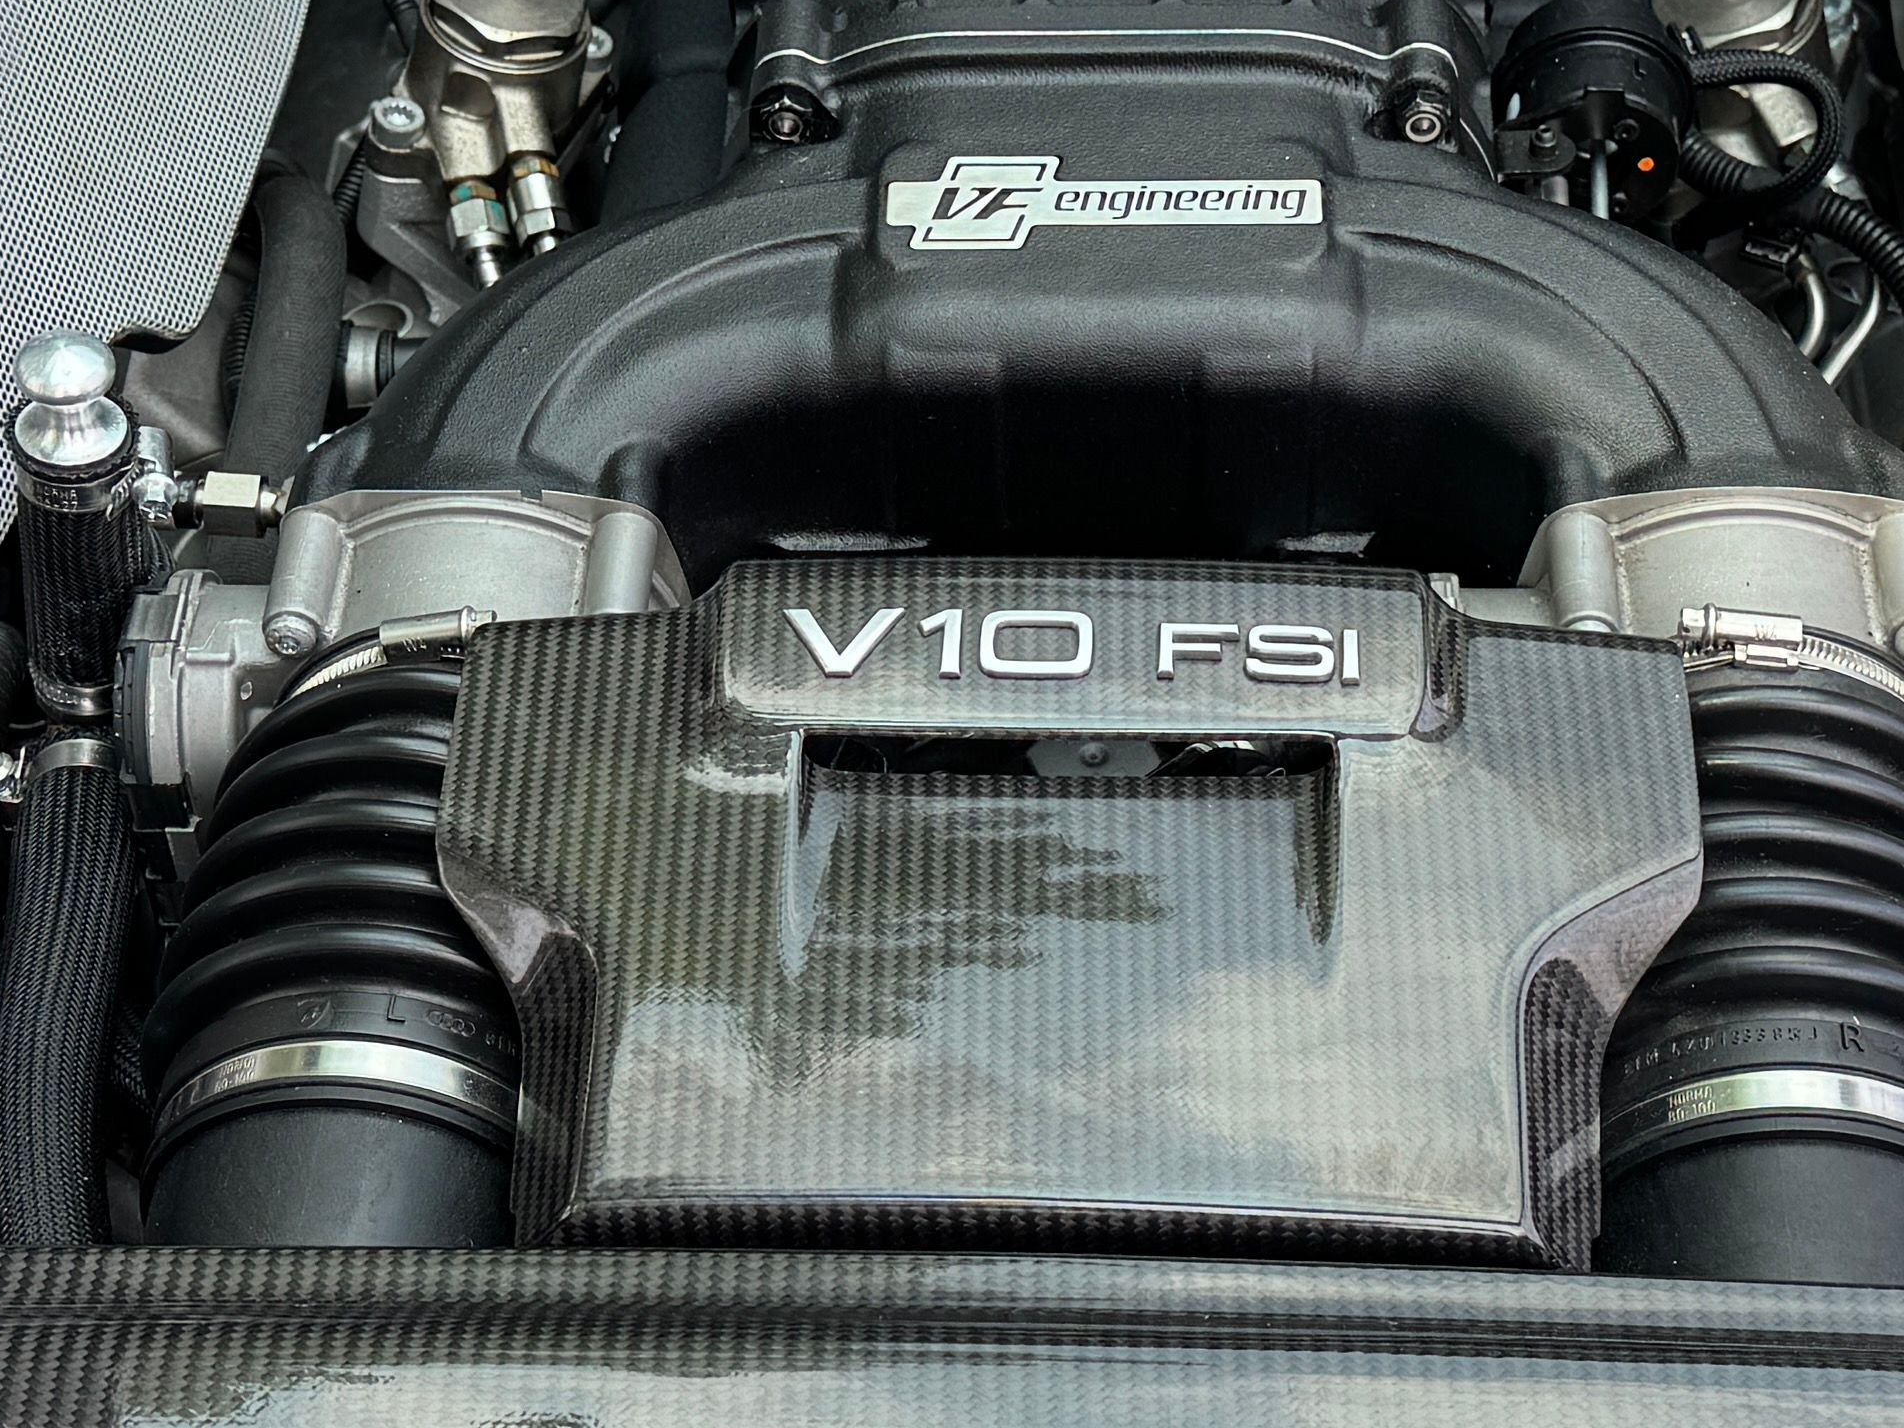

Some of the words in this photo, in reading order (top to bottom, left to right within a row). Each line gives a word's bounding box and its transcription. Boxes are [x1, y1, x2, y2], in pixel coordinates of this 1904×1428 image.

[931, 186, 1044, 221] VF
[1053, 184, 1308, 220] engineering
[782, 607, 1094, 679] V10
[1156, 621, 1361, 687] FSI
[386, 993, 407, 1024] L
[1840, 1023, 1865, 1053] R
